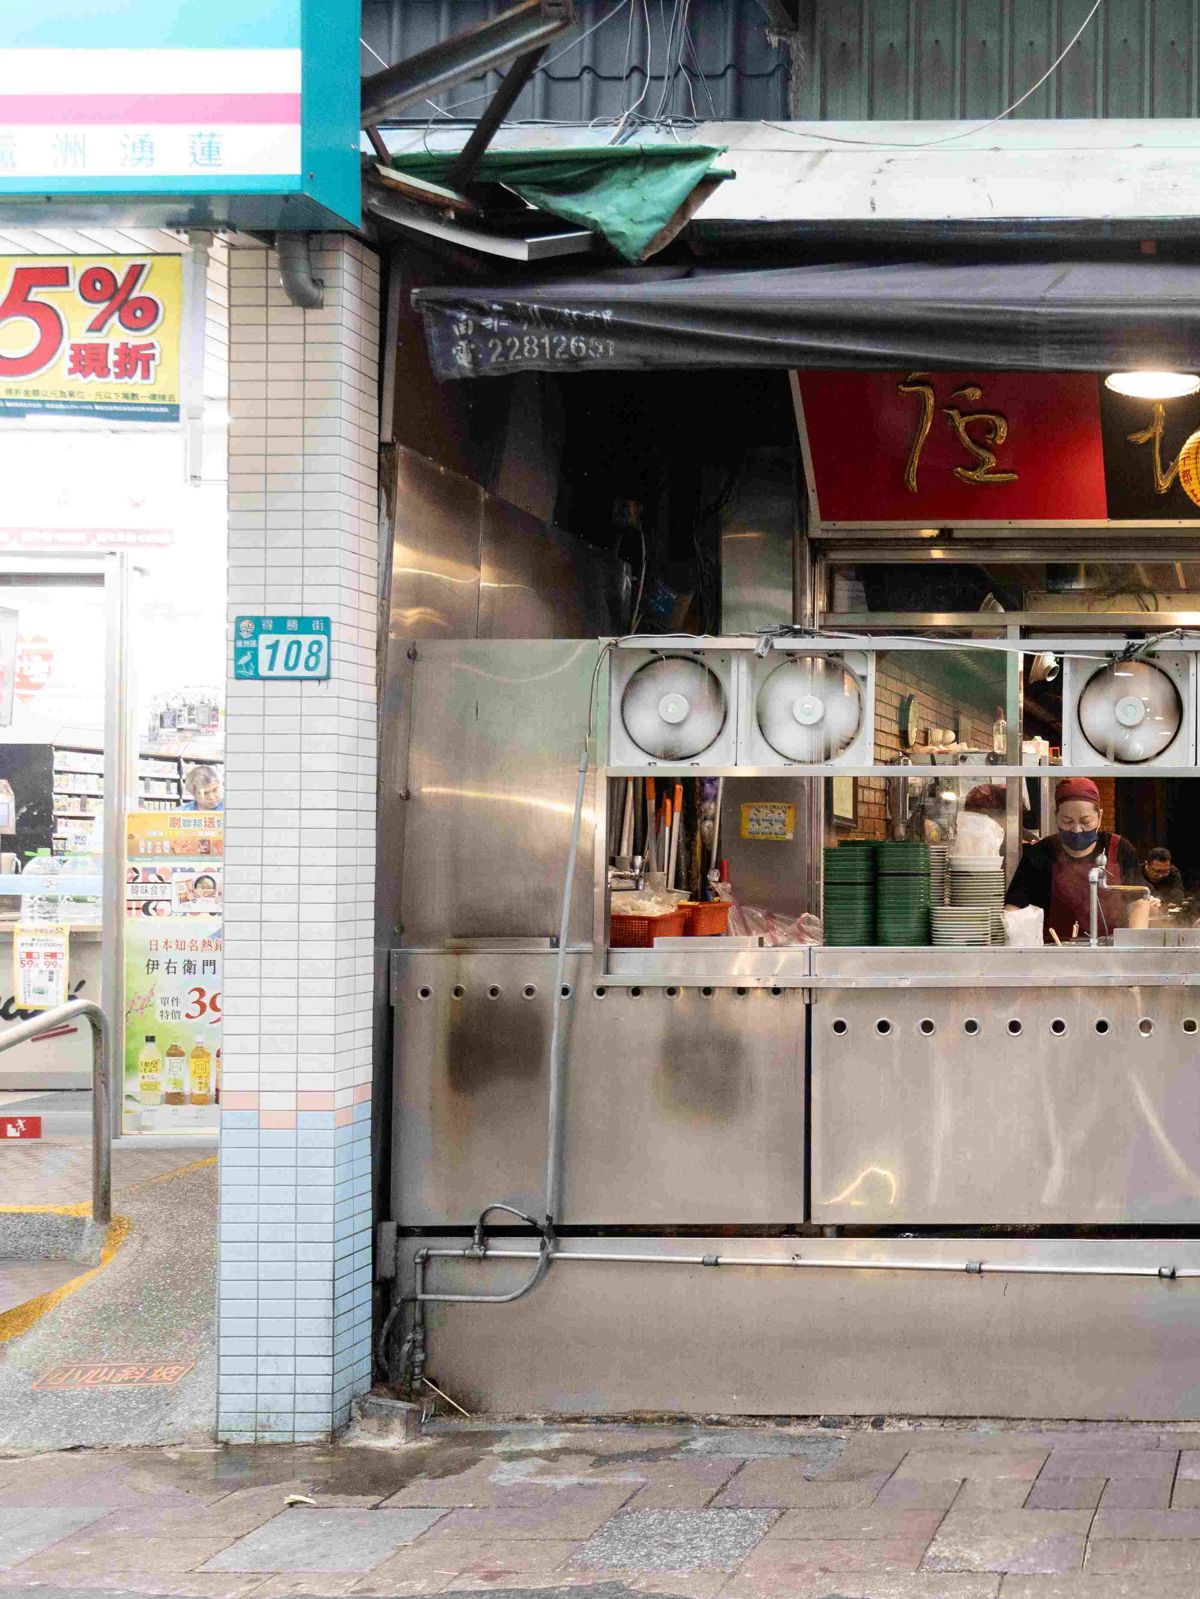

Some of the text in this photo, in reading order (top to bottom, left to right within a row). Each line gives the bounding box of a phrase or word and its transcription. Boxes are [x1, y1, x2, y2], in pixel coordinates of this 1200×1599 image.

[0, 263, 160, 377] 5%
[67, 342, 155, 380] 現折
[265, 640, 323, 672] 108
[145, 959, 217, 976] 伊右衛門
[49, 1366, 184, 1384] 小心斜坡
